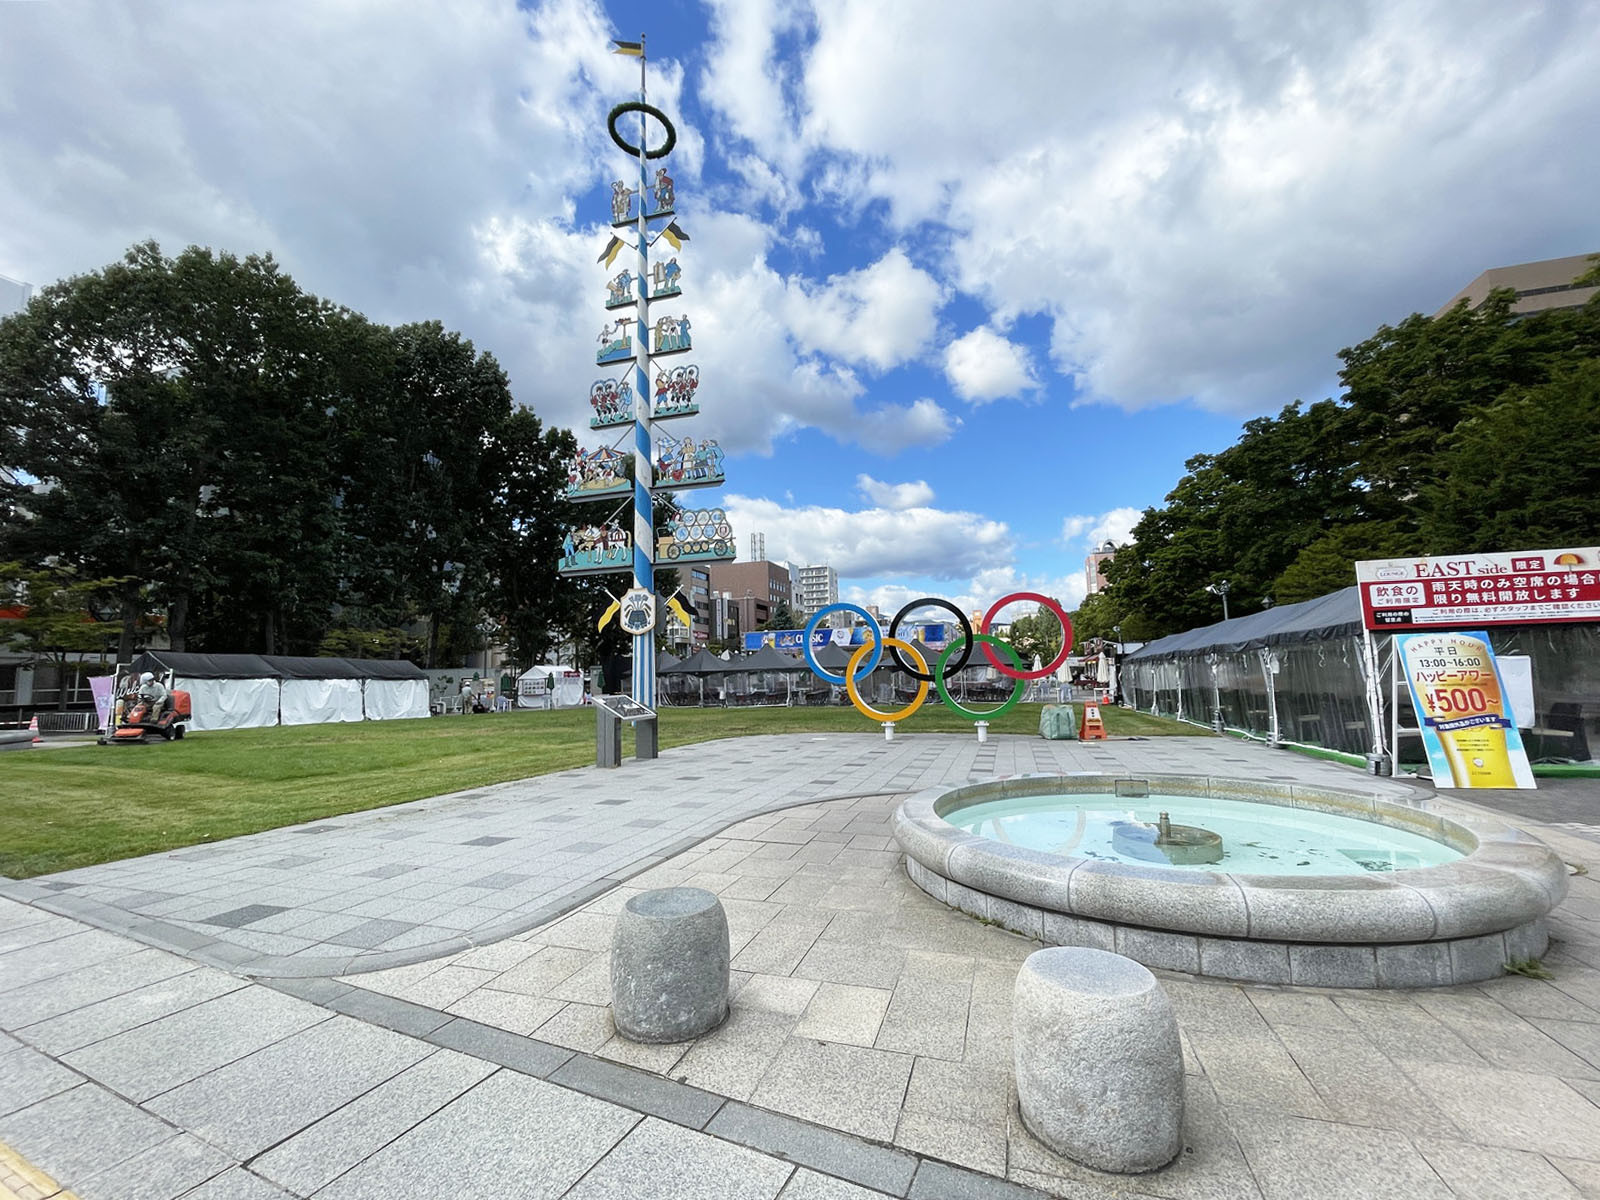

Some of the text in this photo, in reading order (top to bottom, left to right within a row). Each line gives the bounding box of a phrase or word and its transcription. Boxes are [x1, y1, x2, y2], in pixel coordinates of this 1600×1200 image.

[1413, 560, 1508, 578] EAST side
[1515, 560, 1541, 570] 限定
[1431, 573, 1600, 592] 雨天時のみ空席の場合
[1376, 585, 1418, 597] 飲食の
[1433, 588, 1580, 605] 限り無料開放します
[795, 633, 824, 644] CLSIC
[1410, 638, 1482, 653] HAPPY HOUR
[1434, 646, 1458, 656] 平日
[1416, 670, 1491, 683] ハッピーアワー
